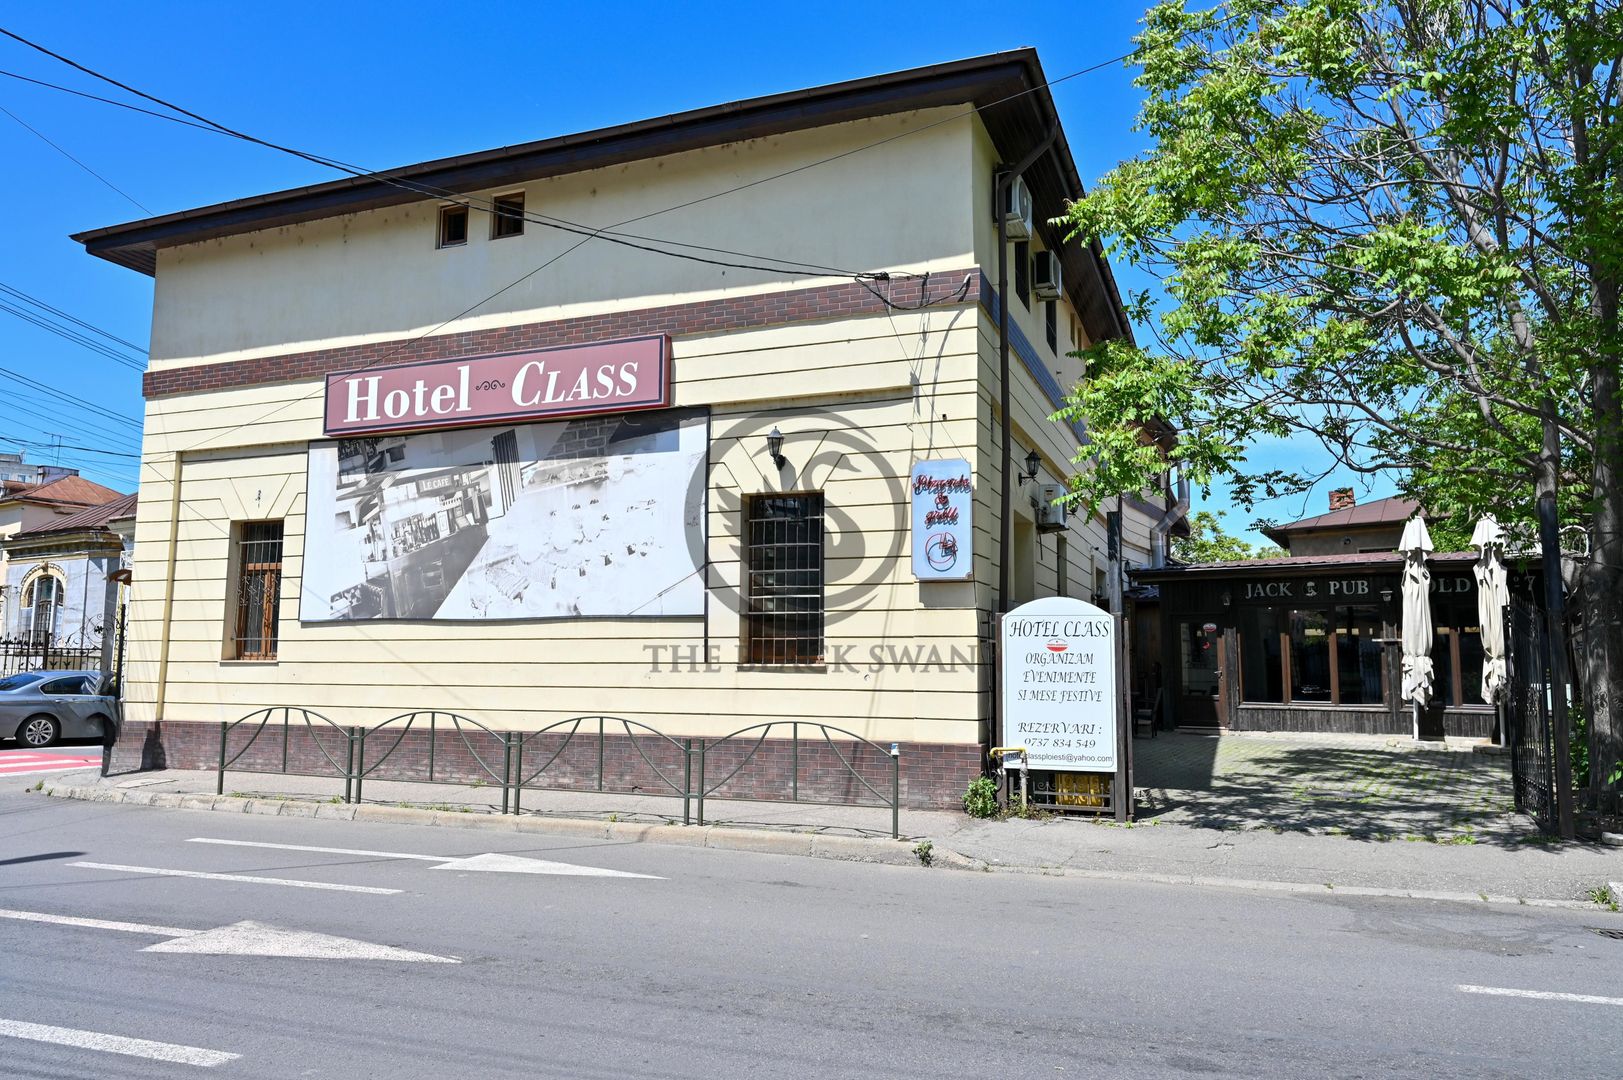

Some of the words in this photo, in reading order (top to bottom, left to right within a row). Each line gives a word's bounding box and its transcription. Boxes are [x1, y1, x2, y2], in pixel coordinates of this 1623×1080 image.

[343, 365, 472, 422] Hotel
[511, 361, 638, 406] CLASS
[1245, 582, 1293, 599] JACK
[1328, 580, 1369, 596] PUB
[1009, 619, 1059, 637] HOTEL
[1064, 620, 1110, 637] CLASS
[1025, 652, 1094, 667] ORGANIZAM
[1023, 669, 1097, 684] EVENIMENTE
[1018, 689, 1027, 701] SI
[1030, 689, 1057, 702] MESE
[1059, 689, 1103, 704] FESTIVE
[1018, 721, 1096, 735] REZERVARI
[1024, 737, 1049, 747] 0737
[1052, 739, 1072, 748] 834
[1076, 739, 1096, 749] 549
